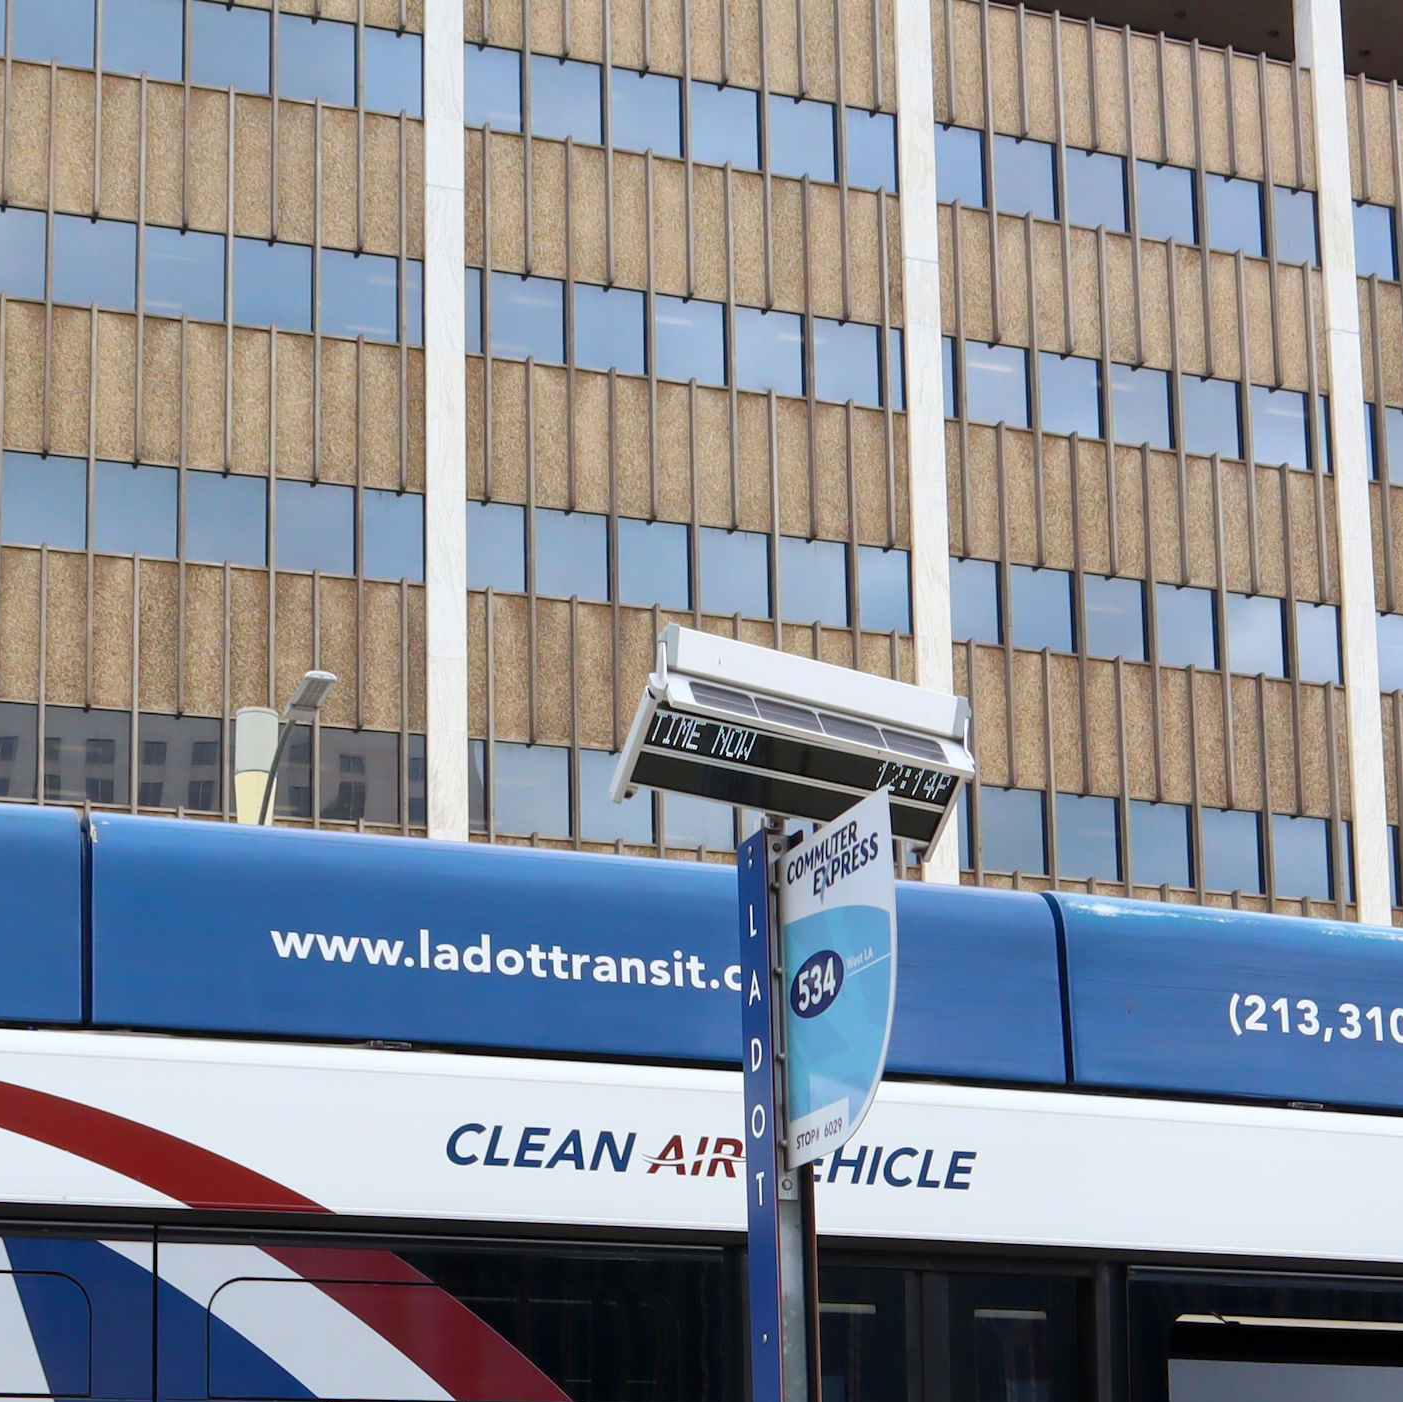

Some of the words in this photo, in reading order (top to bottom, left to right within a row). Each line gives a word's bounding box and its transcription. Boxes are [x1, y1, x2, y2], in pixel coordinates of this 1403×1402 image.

[651, 711, 706, 750] TIME
[711, 724, 758, 761] NOW
[787, 820, 858, 885] COMMUTER
[813, 832, 879, 896] EXPRESS
[271, 928, 742, 992] www.ladottransit.c
[798, 957, 836, 1012] 534
[446, 1123, 636, 1173] CLEAN
[644, 1134, 746, 1178] AIR
[813, 1145, 977, 1190] HICLE
[796, 1127, 820, 1150] STOP#
[824, 1117, 843, 1138] 6029
